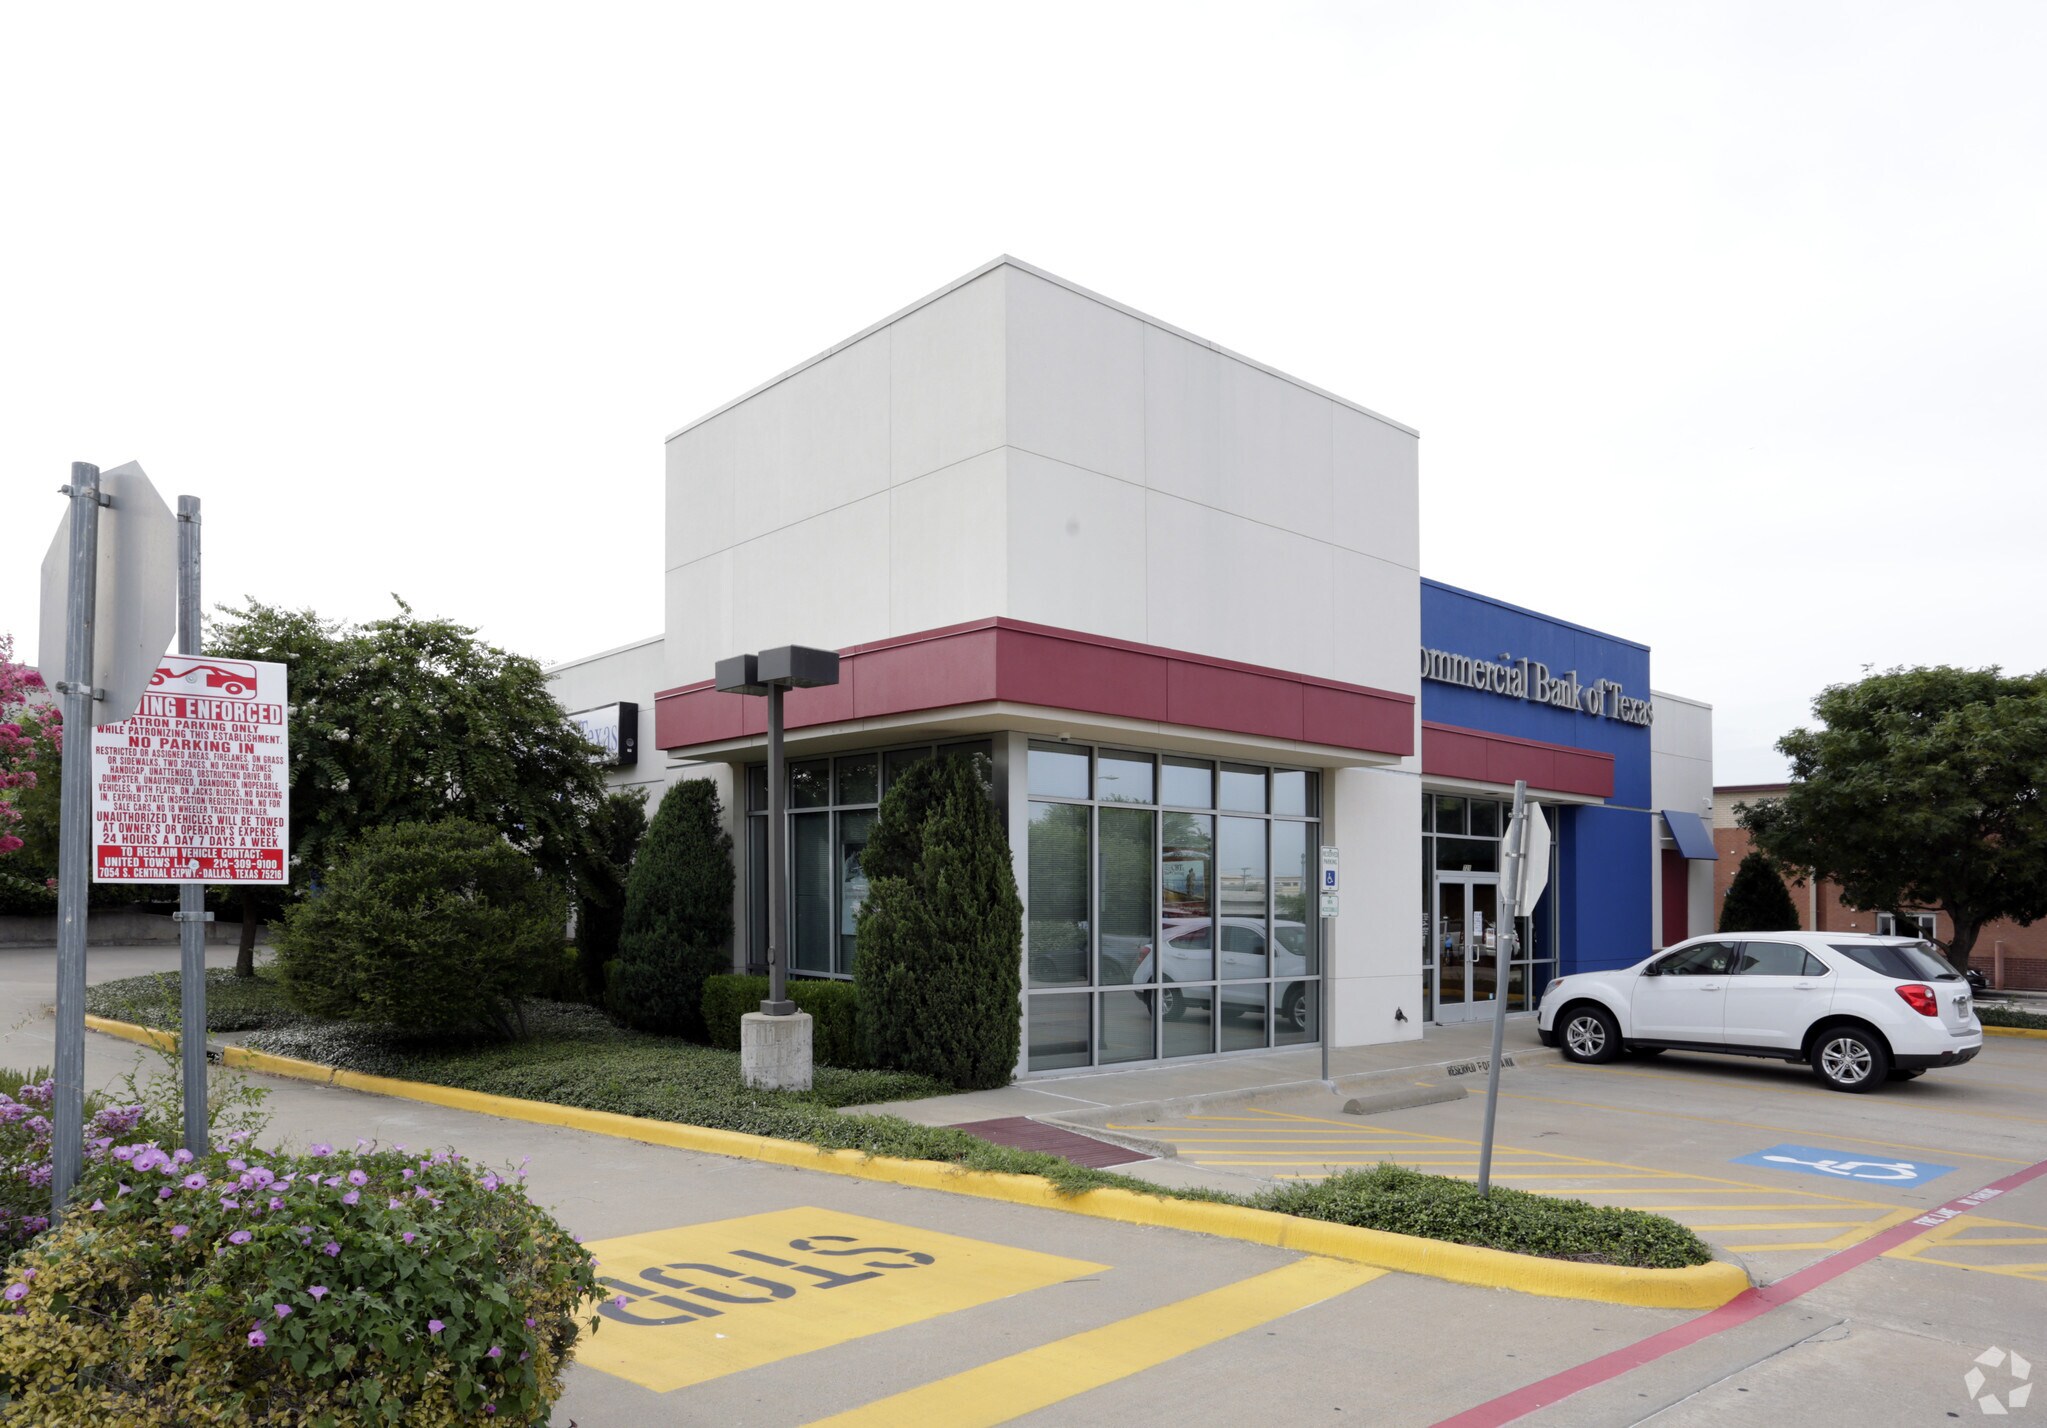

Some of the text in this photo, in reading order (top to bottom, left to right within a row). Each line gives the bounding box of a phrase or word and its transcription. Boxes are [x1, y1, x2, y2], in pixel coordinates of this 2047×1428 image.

[1421, 646, 1654, 726] ommercial Bank of Texas
[133, 695, 280, 724] ING ENFORCED
[175, 720, 225, 731] PARKING
[231, 724, 258, 733] ONLY
[97, 724, 281, 744] WHILE PATRONIZING THIS ESTABLISHMENT.
[128, 736, 254, 753] NO PARKING IN
[96, 747, 137, 756] RESTRICTED
[140, 749, 148, 757] OR
[151, 750, 184, 759] ASSIGNED
[252, 755, 260, 763] ON
[263, 756, 283, 764] GRASS
[164, 759, 177, 767] TWO
[222, 762, 248, 771] PARKING
[196, 770, 240, 779] OBSTRUCTING
[243, 772, 259, 780] DRIVE
[135, 785, 152, 793] WITH
[255, 790, 282, 798] BACKING
[241, 781, 277, 789] INOPERABLE
[113, 793, 140, 802] EXPIRED
[113, 802, 129, 810] SALE
[178, 805, 207, 813] WHEELER
[96, 811, 283, 827] UNAUTHORIZED VEHICLES WILL BE TOWED
[103, 822, 278, 837] AT OWNER'S OR OPERATOR'S EXPENSE.
[103, 833, 277, 847] 24 HOURS A DAY 7 DAYS A WEEK
[121, 846, 262, 858] TO RECLAIM VEHICLE CONTACT:
[105, 857, 276, 868] UNITED TOWS L.L. 214-309-9100
[99, 867, 119, 877] 7054
[123, 868, 129, 877] S.
[134, 868, 167, 877] CENTRAL
[236, 869, 258, 878] TEXAS
[262, 870, 281, 879] 75216
[1447, 1064, 1476, 1077] RESERVED
[1500, 1057, 1515, 1068] ANK
[595, 1235, 936, 1327] STOP
